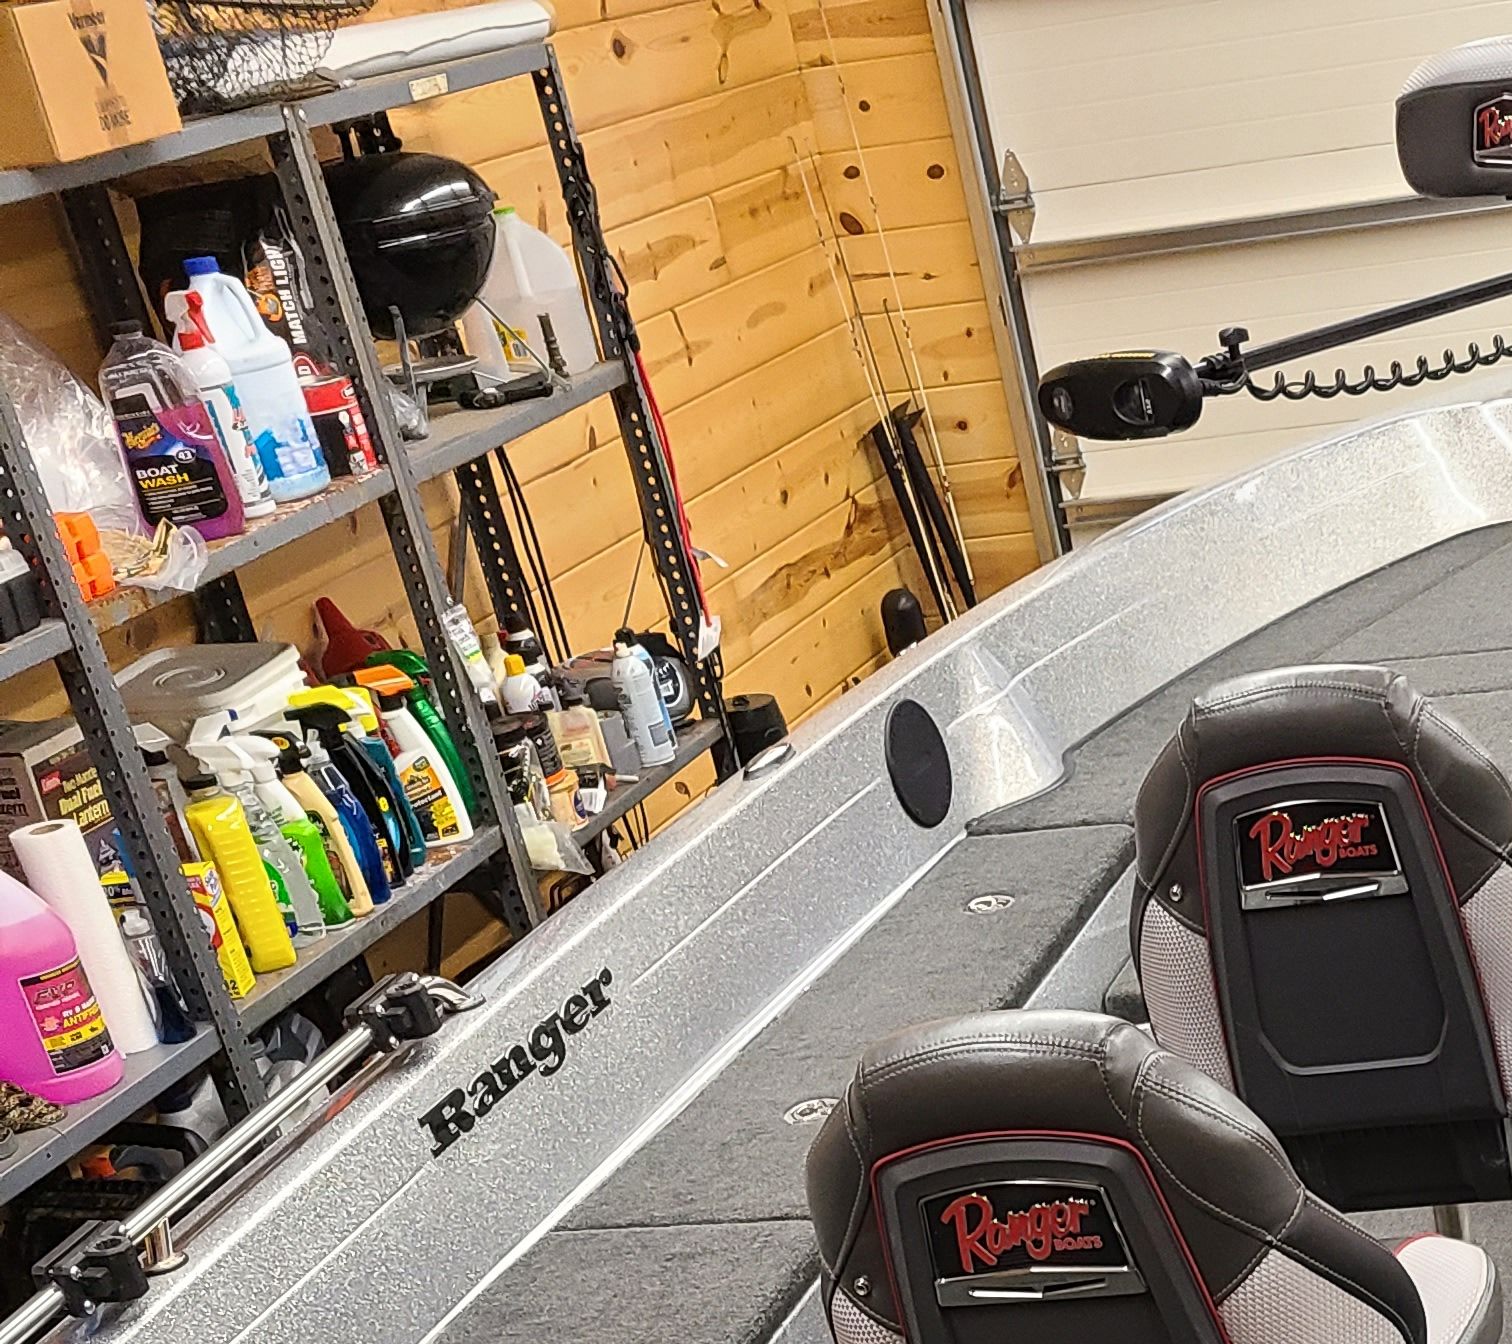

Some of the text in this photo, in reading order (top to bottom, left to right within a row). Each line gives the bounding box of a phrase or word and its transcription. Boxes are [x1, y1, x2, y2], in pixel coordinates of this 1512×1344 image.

[278, 290, 308, 345] MATCH
[135, 463, 179, 480] BOAT
[138, 472, 190, 490] WASH
[58, 791, 83, 817] Dual
[81, 779, 104, 805] Fuel
[73, 800, 112, 828] Lantern
[1249, 811, 1370, 881] Ranger
[1339, 844, 1379, 859] BOATS
[417, 966, 613, 1159] Ranger
[940, 1193, 1090, 1274] Ranger
[1053, 1235, 1103, 1251] BOATS
